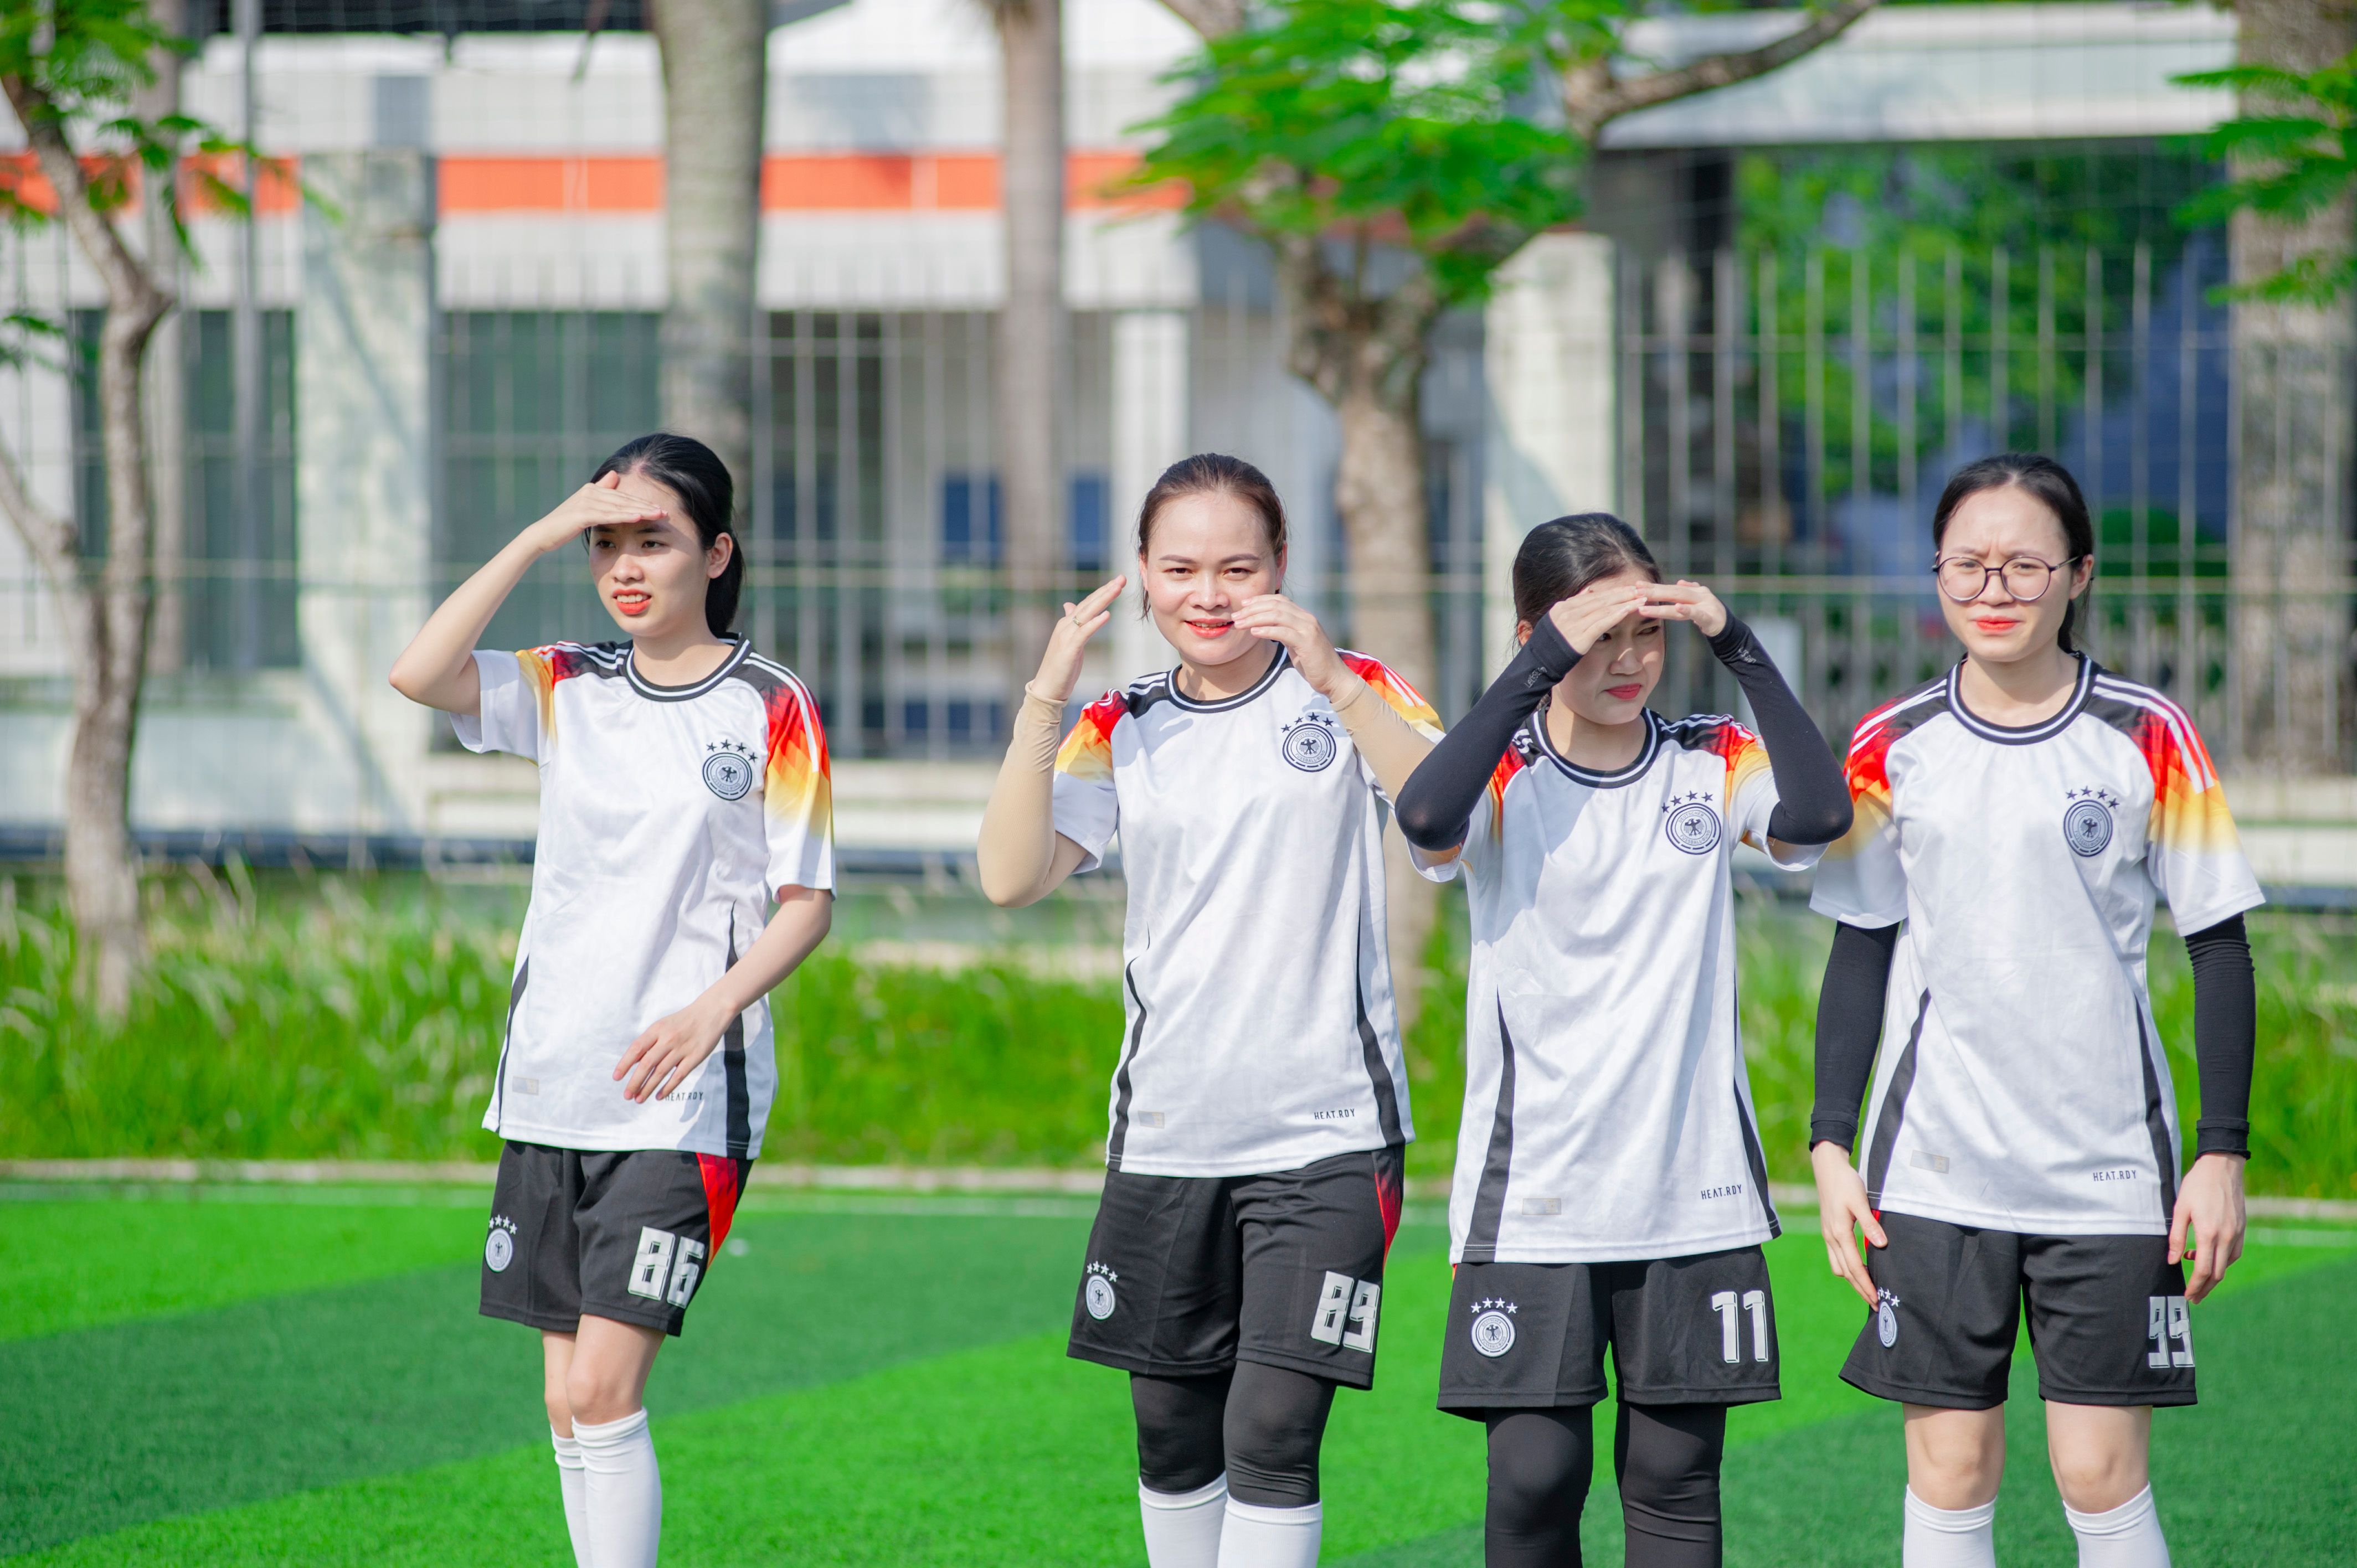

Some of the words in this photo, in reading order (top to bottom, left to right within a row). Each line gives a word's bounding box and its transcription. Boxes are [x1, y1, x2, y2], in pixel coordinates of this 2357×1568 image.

[1295, 732, 1320, 742] DEUTSCHER
[1679, 812, 1704, 823] DEUTSCHER
[1314, 1108, 1355, 1120] HEAT.RDY
[2093, 1170, 2136, 1181] HEAT.RDY
[1701, 1184, 1742, 1200] HEAT.RDY
[627, 1226, 705, 1309] 86
[1310, 1271, 1380, 1353] 89
[1712, 1290, 1768, 1363] 11
[2148, 1296, 2195, 1369] 99
